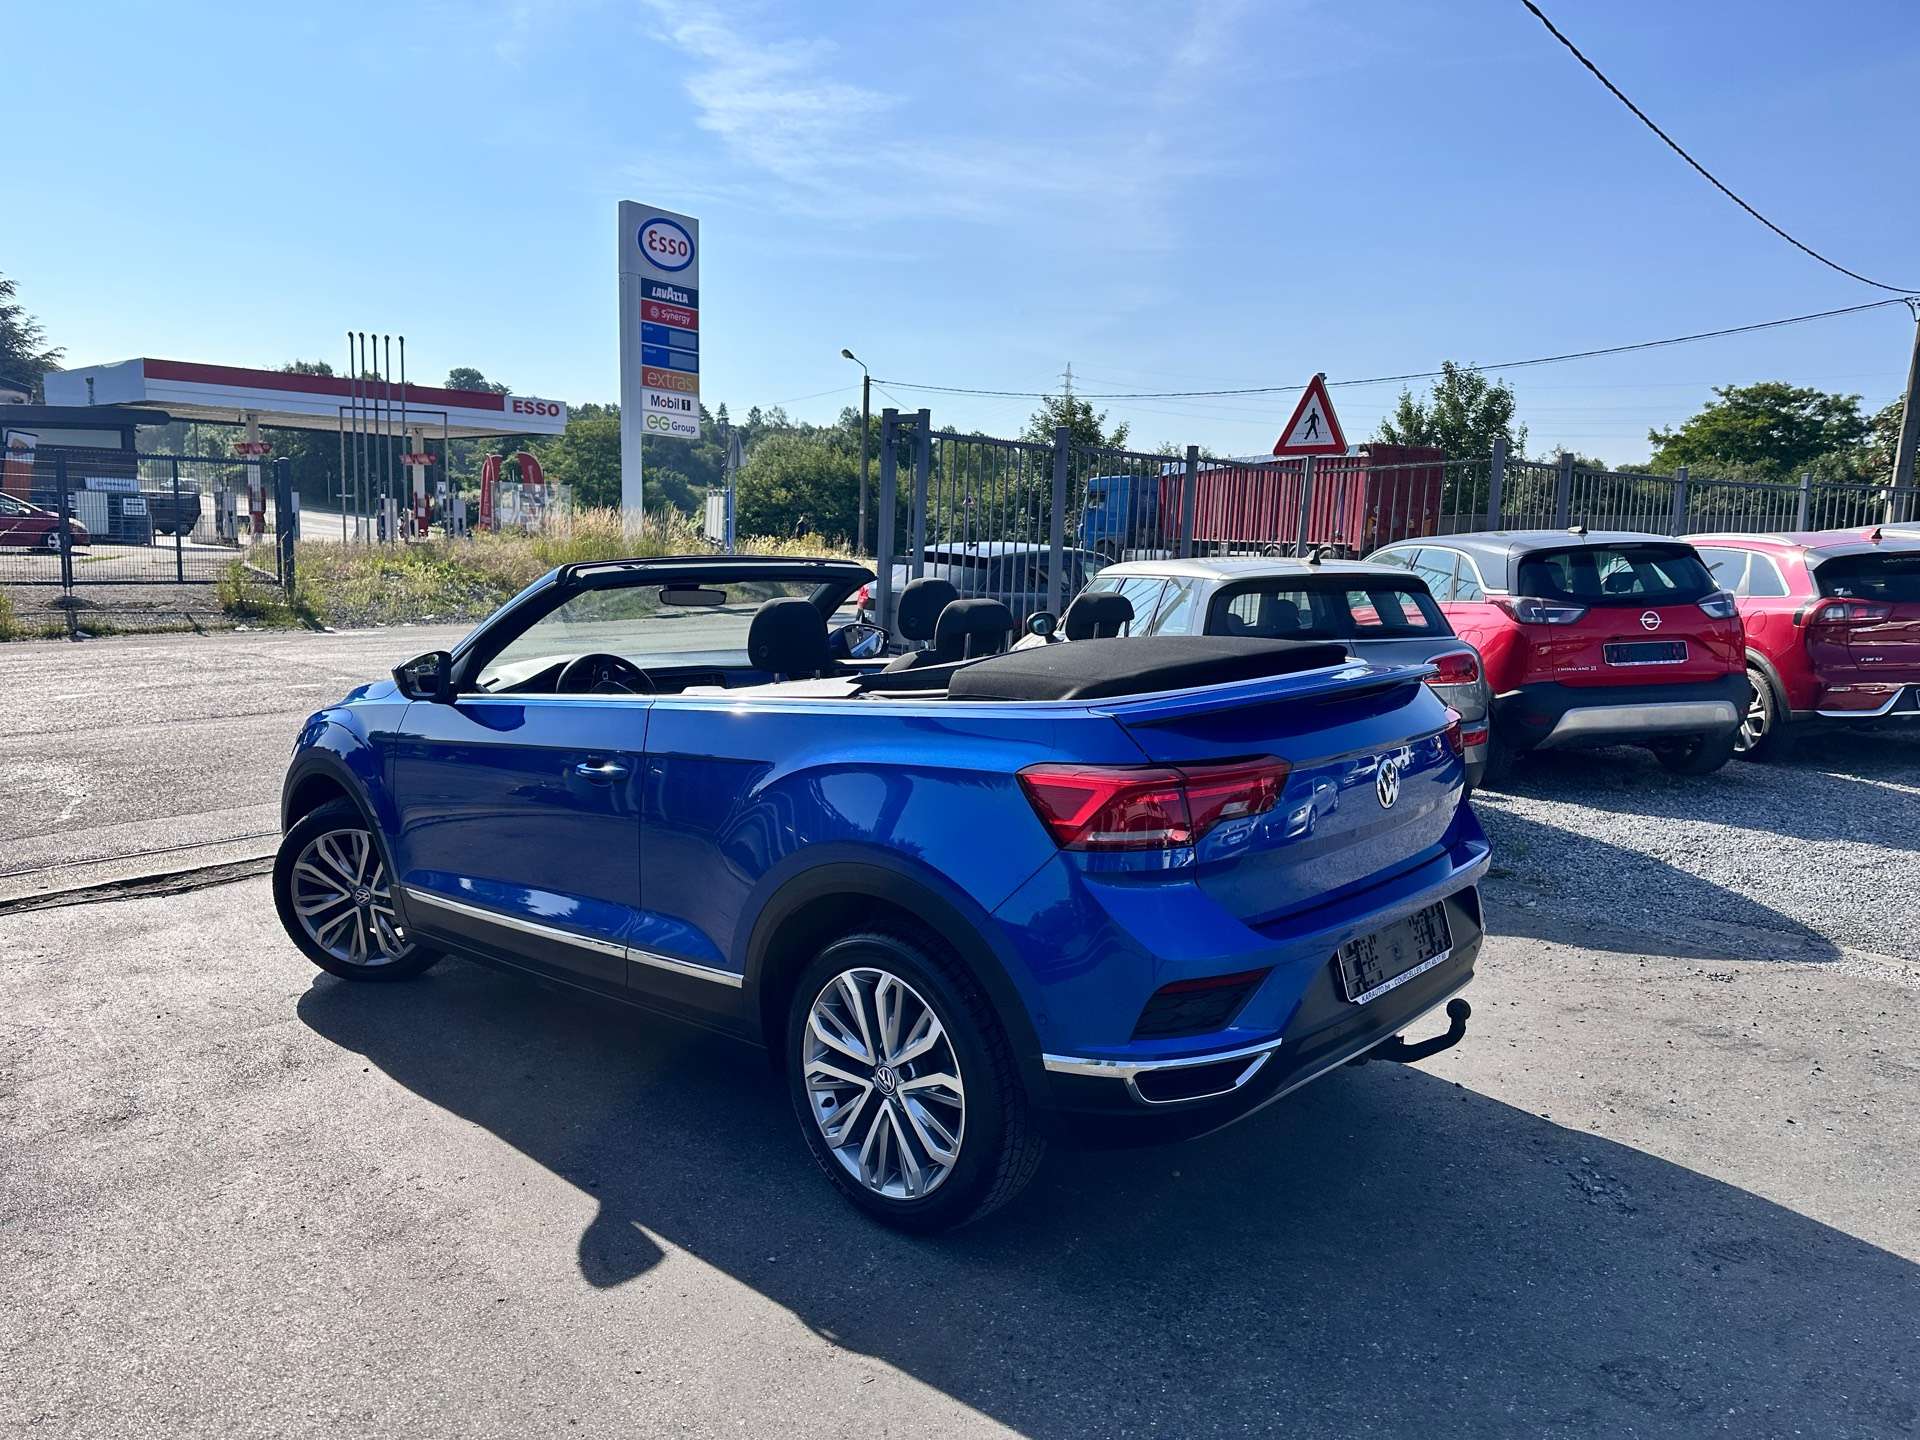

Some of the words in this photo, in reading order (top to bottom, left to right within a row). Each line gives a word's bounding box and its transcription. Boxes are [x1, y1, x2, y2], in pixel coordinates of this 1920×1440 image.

[660, 308, 691, 326] Synergy
[647, 371, 694, 391] extras
[512, 399, 560, 417] ESSO
[650, 394, 680, 410] Mobil
[671, 421, 696, 434] Group
